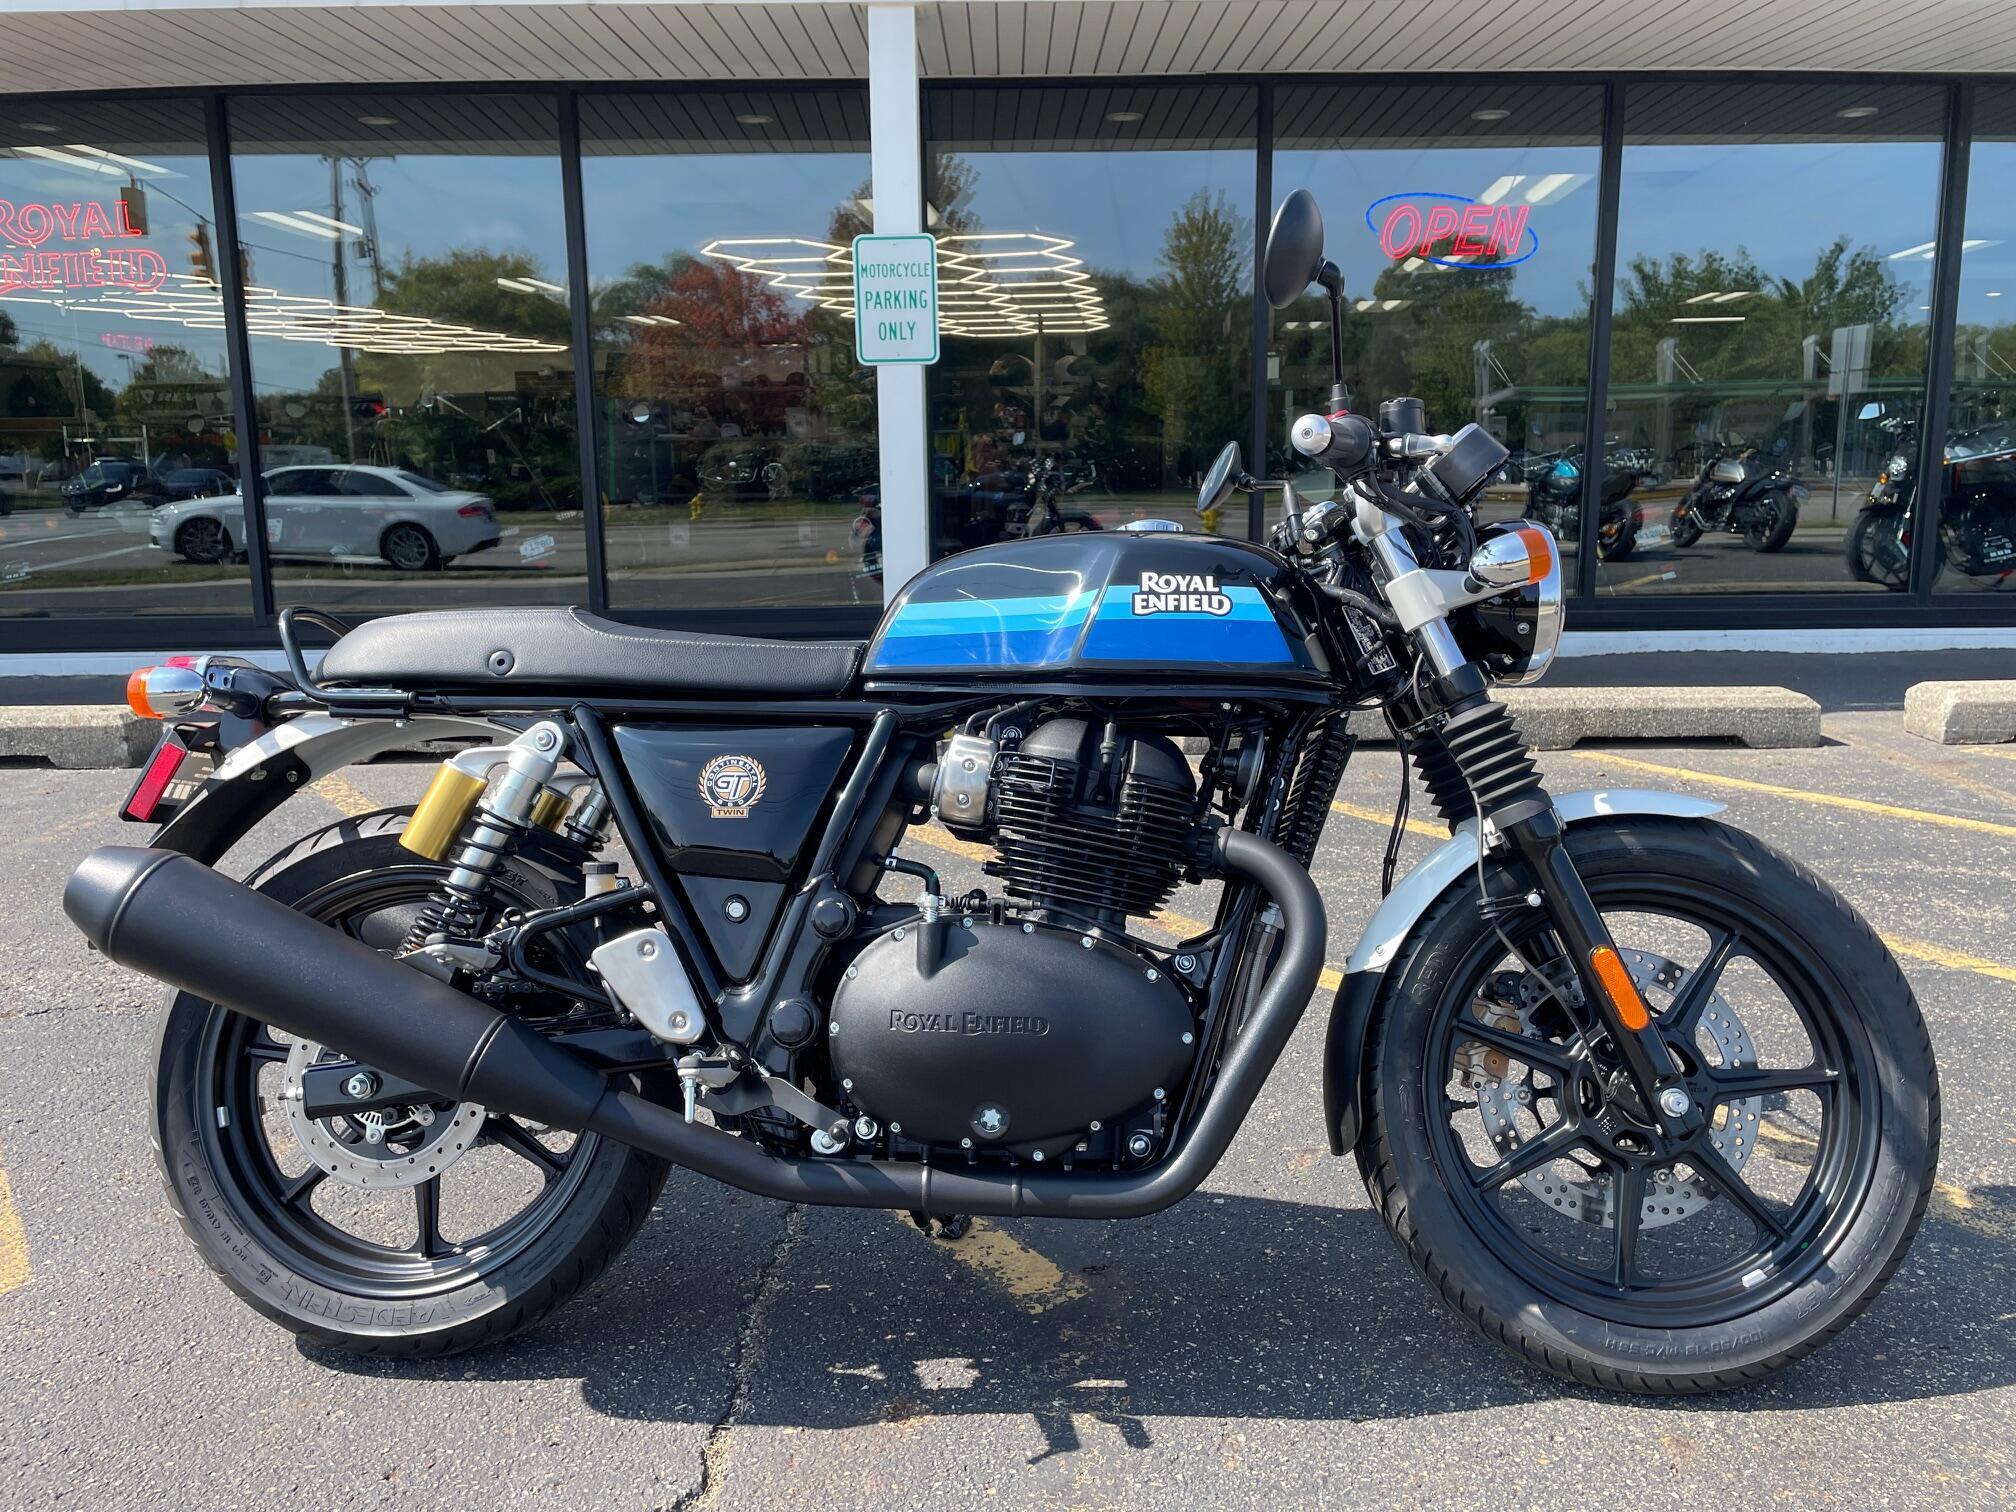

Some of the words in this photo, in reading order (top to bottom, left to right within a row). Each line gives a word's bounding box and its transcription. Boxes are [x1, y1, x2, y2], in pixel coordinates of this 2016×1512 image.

[1381, 203, 1530, 260] OPEN
[0, 248, 167, 295] NFIELD
[860, 262, 931, 279] MOTORCYCLE
[865, 289, 928, 310] PARKING
[878, 320, 916, 341] ONLY
[1141, 571, 1220, 594] ROYAL
[1133, 594, 1231, 616] ENFIELD
[707, 759, 758, 788] CONTINENTAL
[714, 771, 751, 800] GT
[716, 808, 745, 816] TWIN
[889, 1008, 958, 1034] ROYAL
[962, 1011, 1051, 1037] ENFIELD
